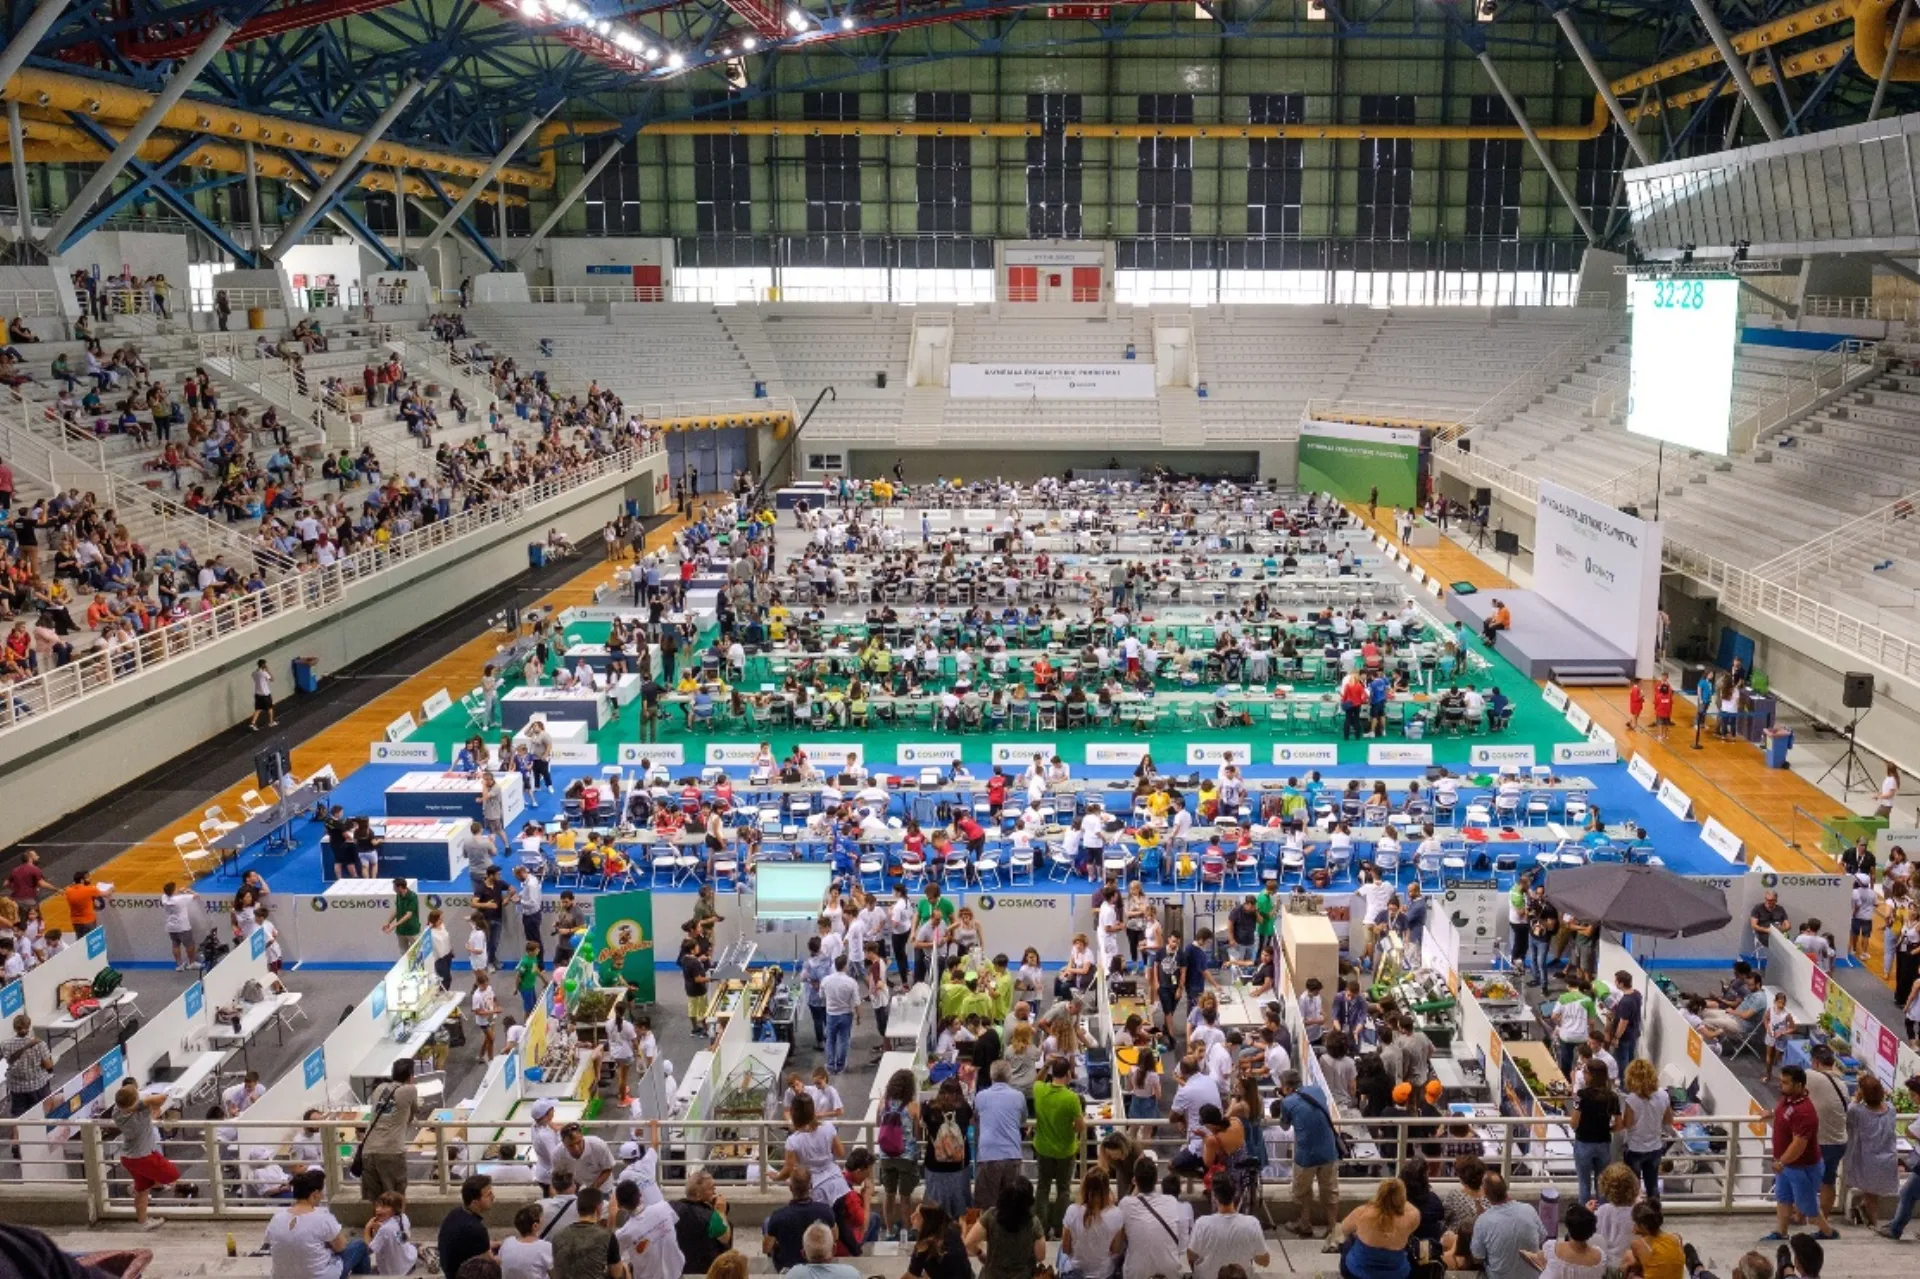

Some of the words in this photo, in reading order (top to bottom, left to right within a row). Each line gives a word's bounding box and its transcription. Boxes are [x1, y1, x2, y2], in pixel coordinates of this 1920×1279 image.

[1654, 281, 1704, 309] 32:28
[1781, 876, 1841, 886] COSMOTE
[331, 899, 390, 909] COSMOTE
[998, 899, 1056, 908] COSMOTE
